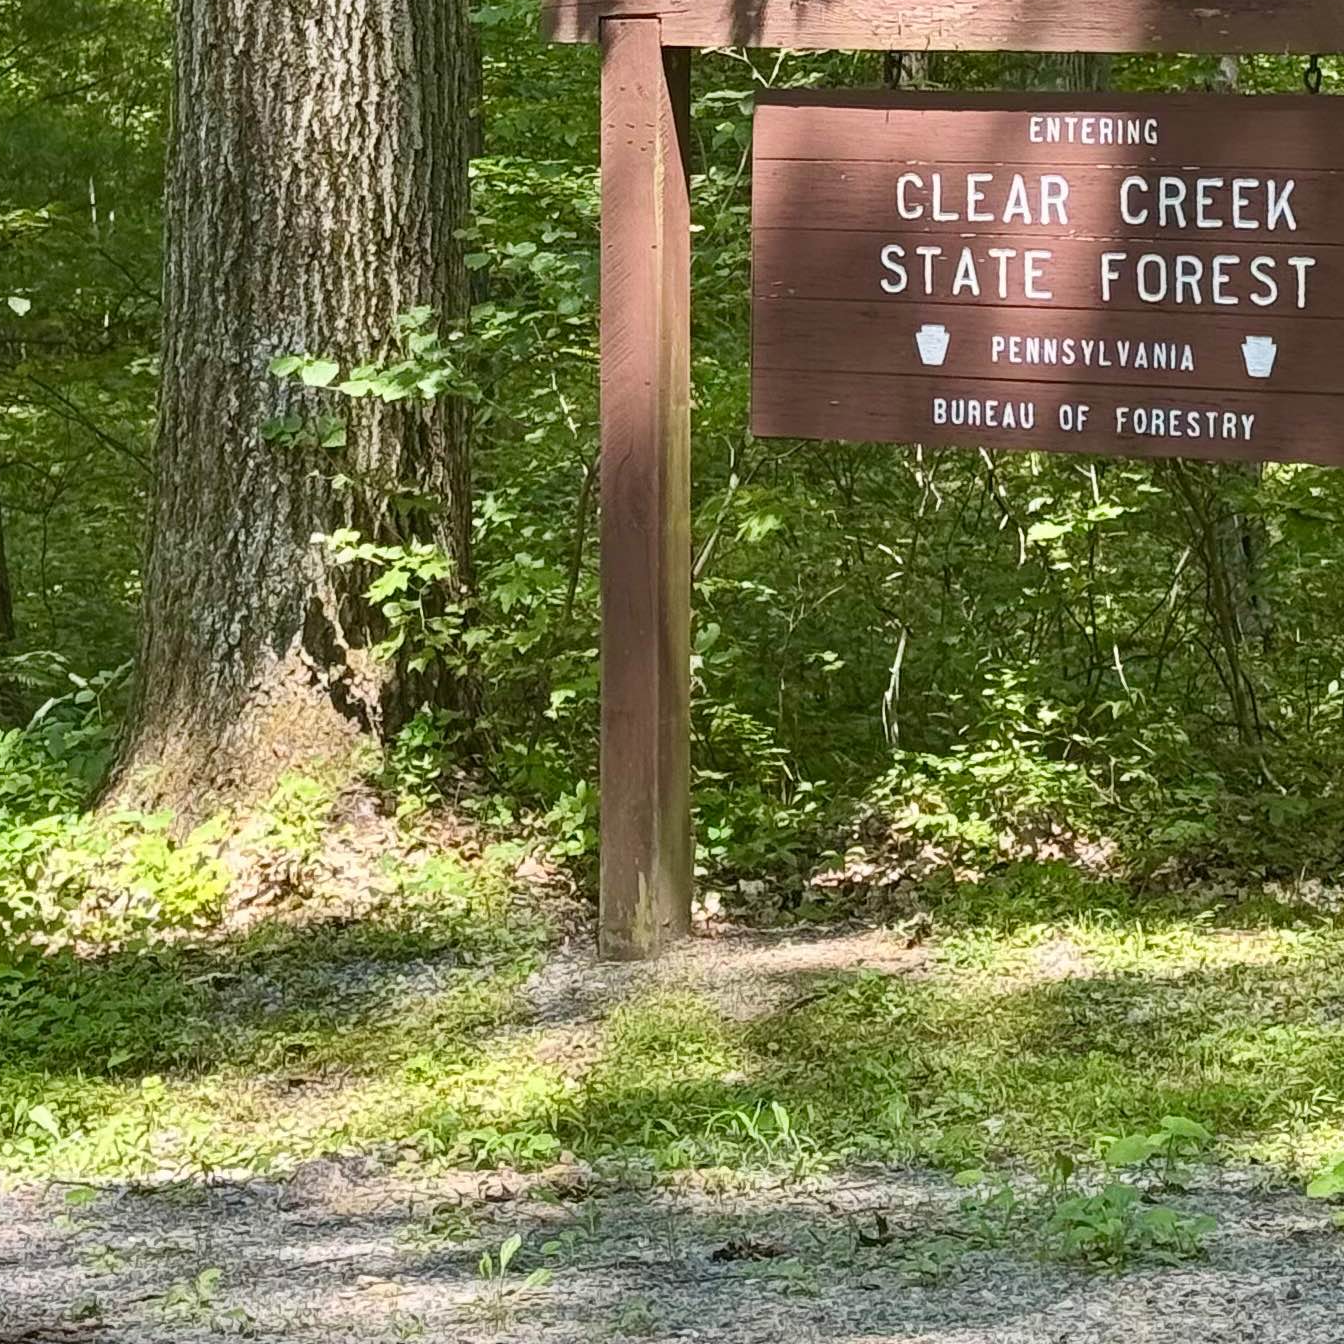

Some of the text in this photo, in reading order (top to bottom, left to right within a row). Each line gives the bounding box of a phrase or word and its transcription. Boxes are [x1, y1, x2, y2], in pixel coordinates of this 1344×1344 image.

[1029, 116, 1157, 145] ENTERING
[896, 172, 1297, 230] CLEAR CREEK
[880, 244, 1316, 308] STATE FOREST
[991, 335, 1194, 371] PENNSYLVANIA
[933, 398, 1255, 441] BUREAU OF FORESTRY
